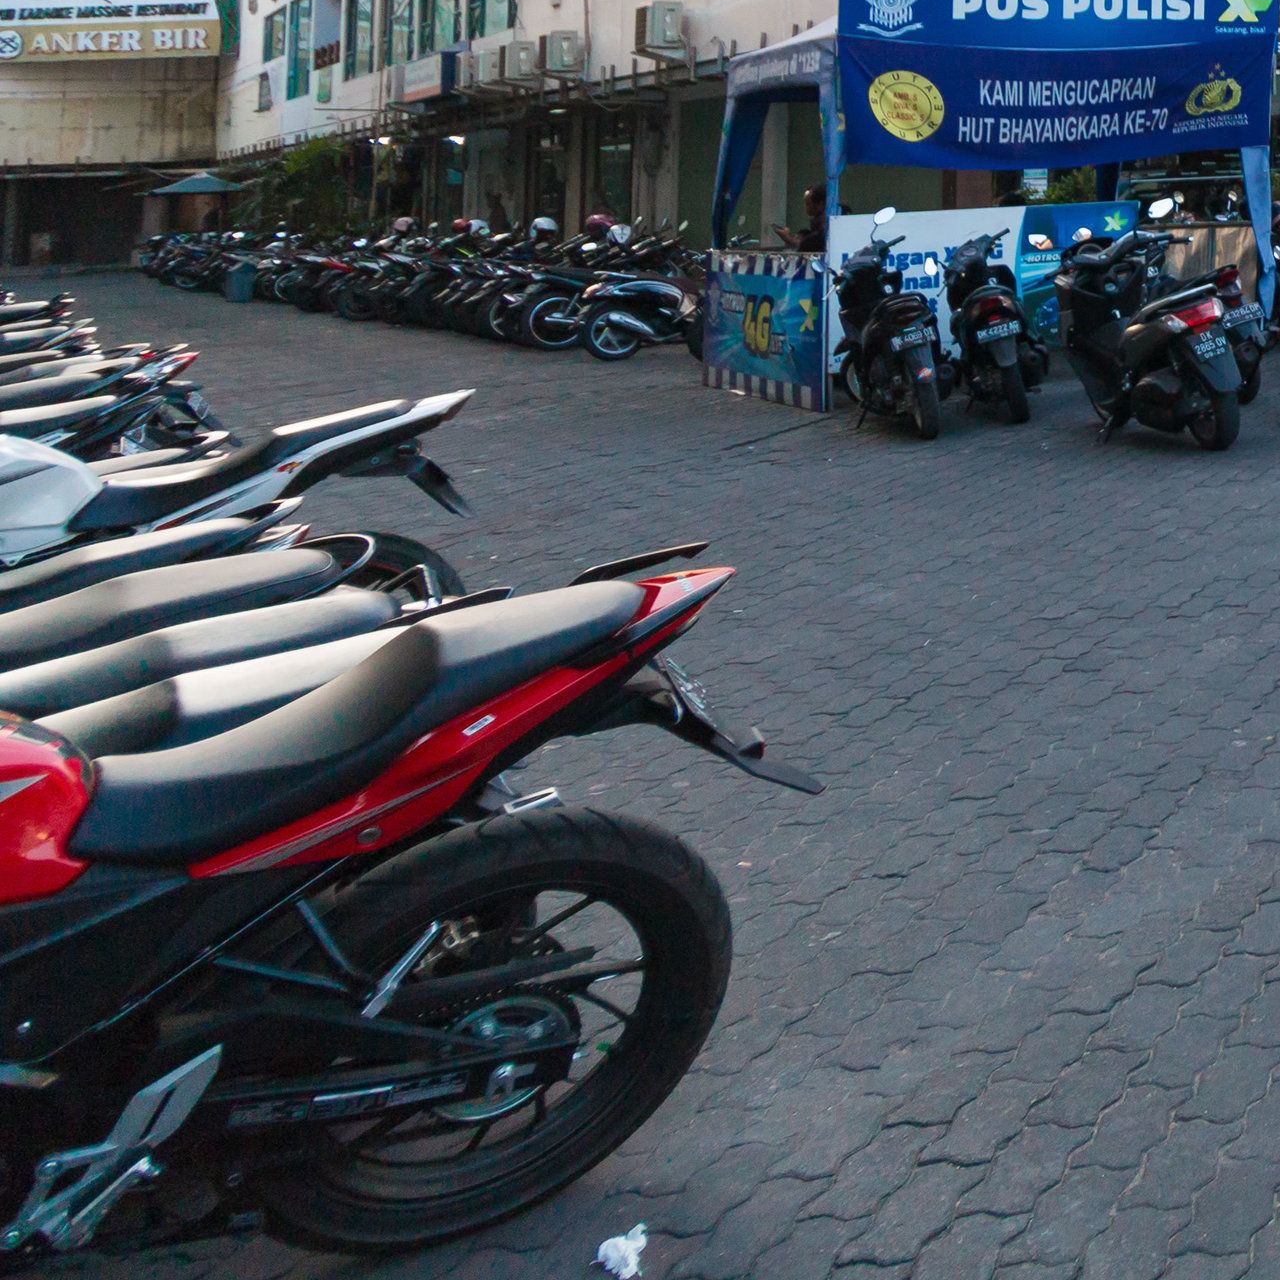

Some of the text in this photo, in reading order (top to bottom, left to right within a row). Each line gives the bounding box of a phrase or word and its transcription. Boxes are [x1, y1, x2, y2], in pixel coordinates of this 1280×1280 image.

[29, 27, 208, 54] ANKER BIR
[979, 76, 1157, 107] KAMI MENGUCAPKAN
[957, 108, 1168, 144] HUT BHAYANGKARA KE-70
[1199, 330, 1213, 342] DK
